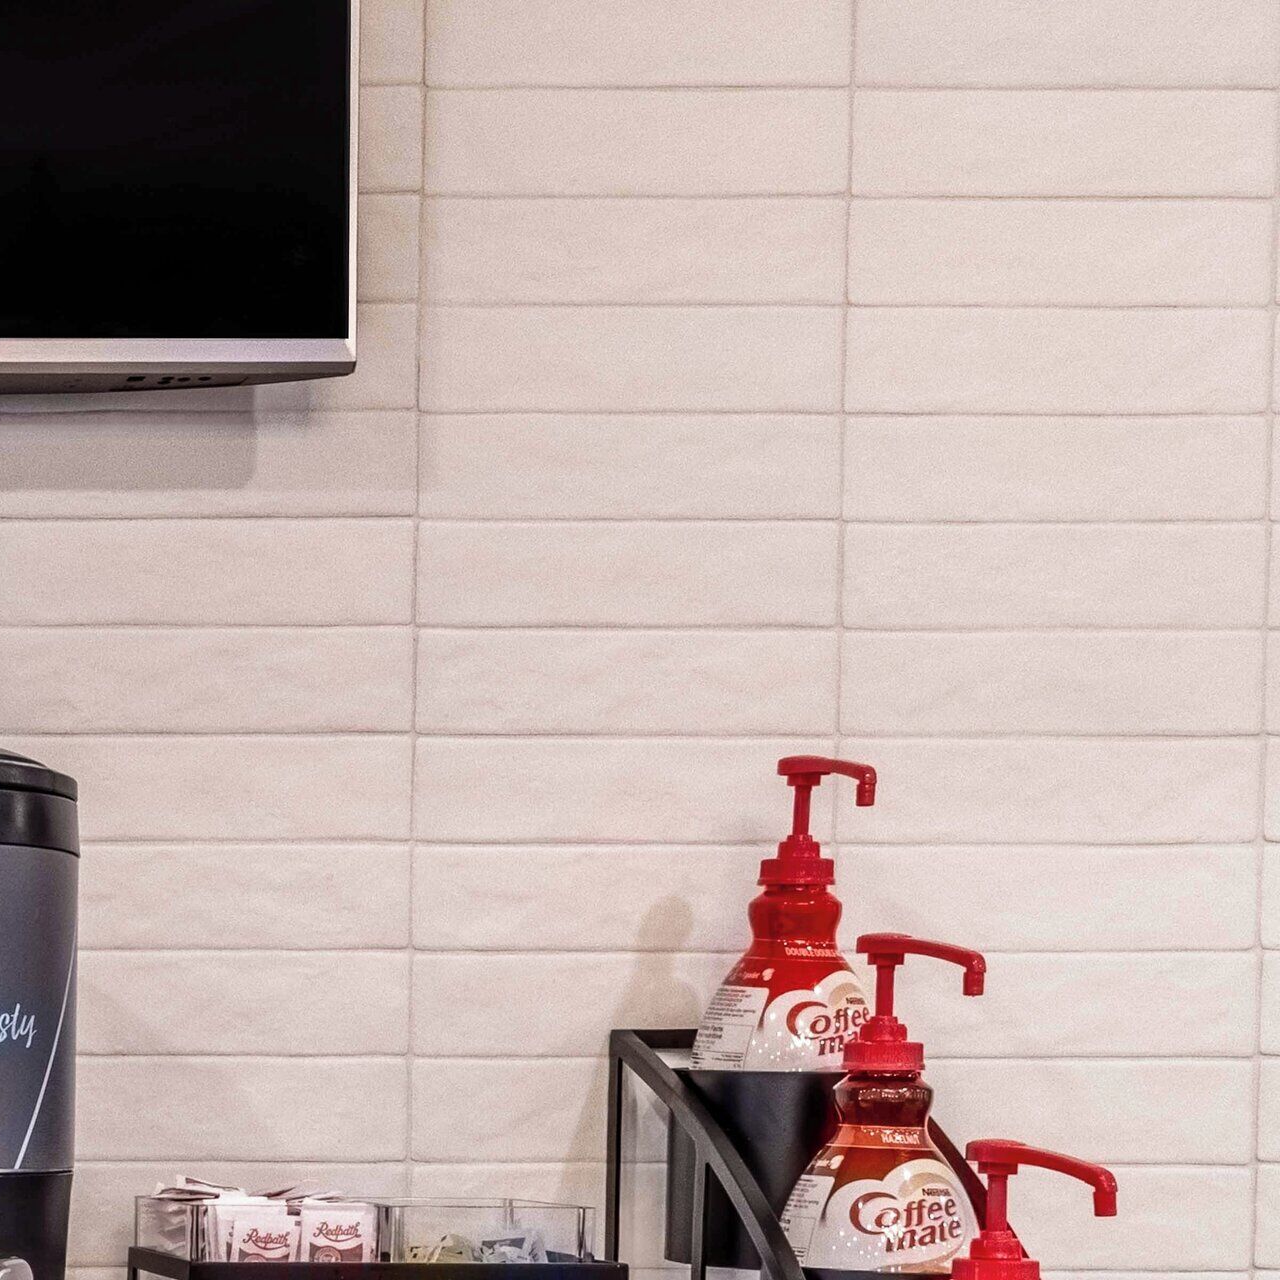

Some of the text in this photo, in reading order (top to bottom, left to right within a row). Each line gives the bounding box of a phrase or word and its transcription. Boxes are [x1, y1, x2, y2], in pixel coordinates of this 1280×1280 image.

[786, 1001, 870, 1040] Coffee
[818, 1030, 860, 1056] ma
[881, 1133, 920, 1145] HAZELNUT
[849, 1191, 957, 1235] Coffee
[242, 1228, 290, 1250] Redpath
[313, 1221, 362, 1243] Redpath
